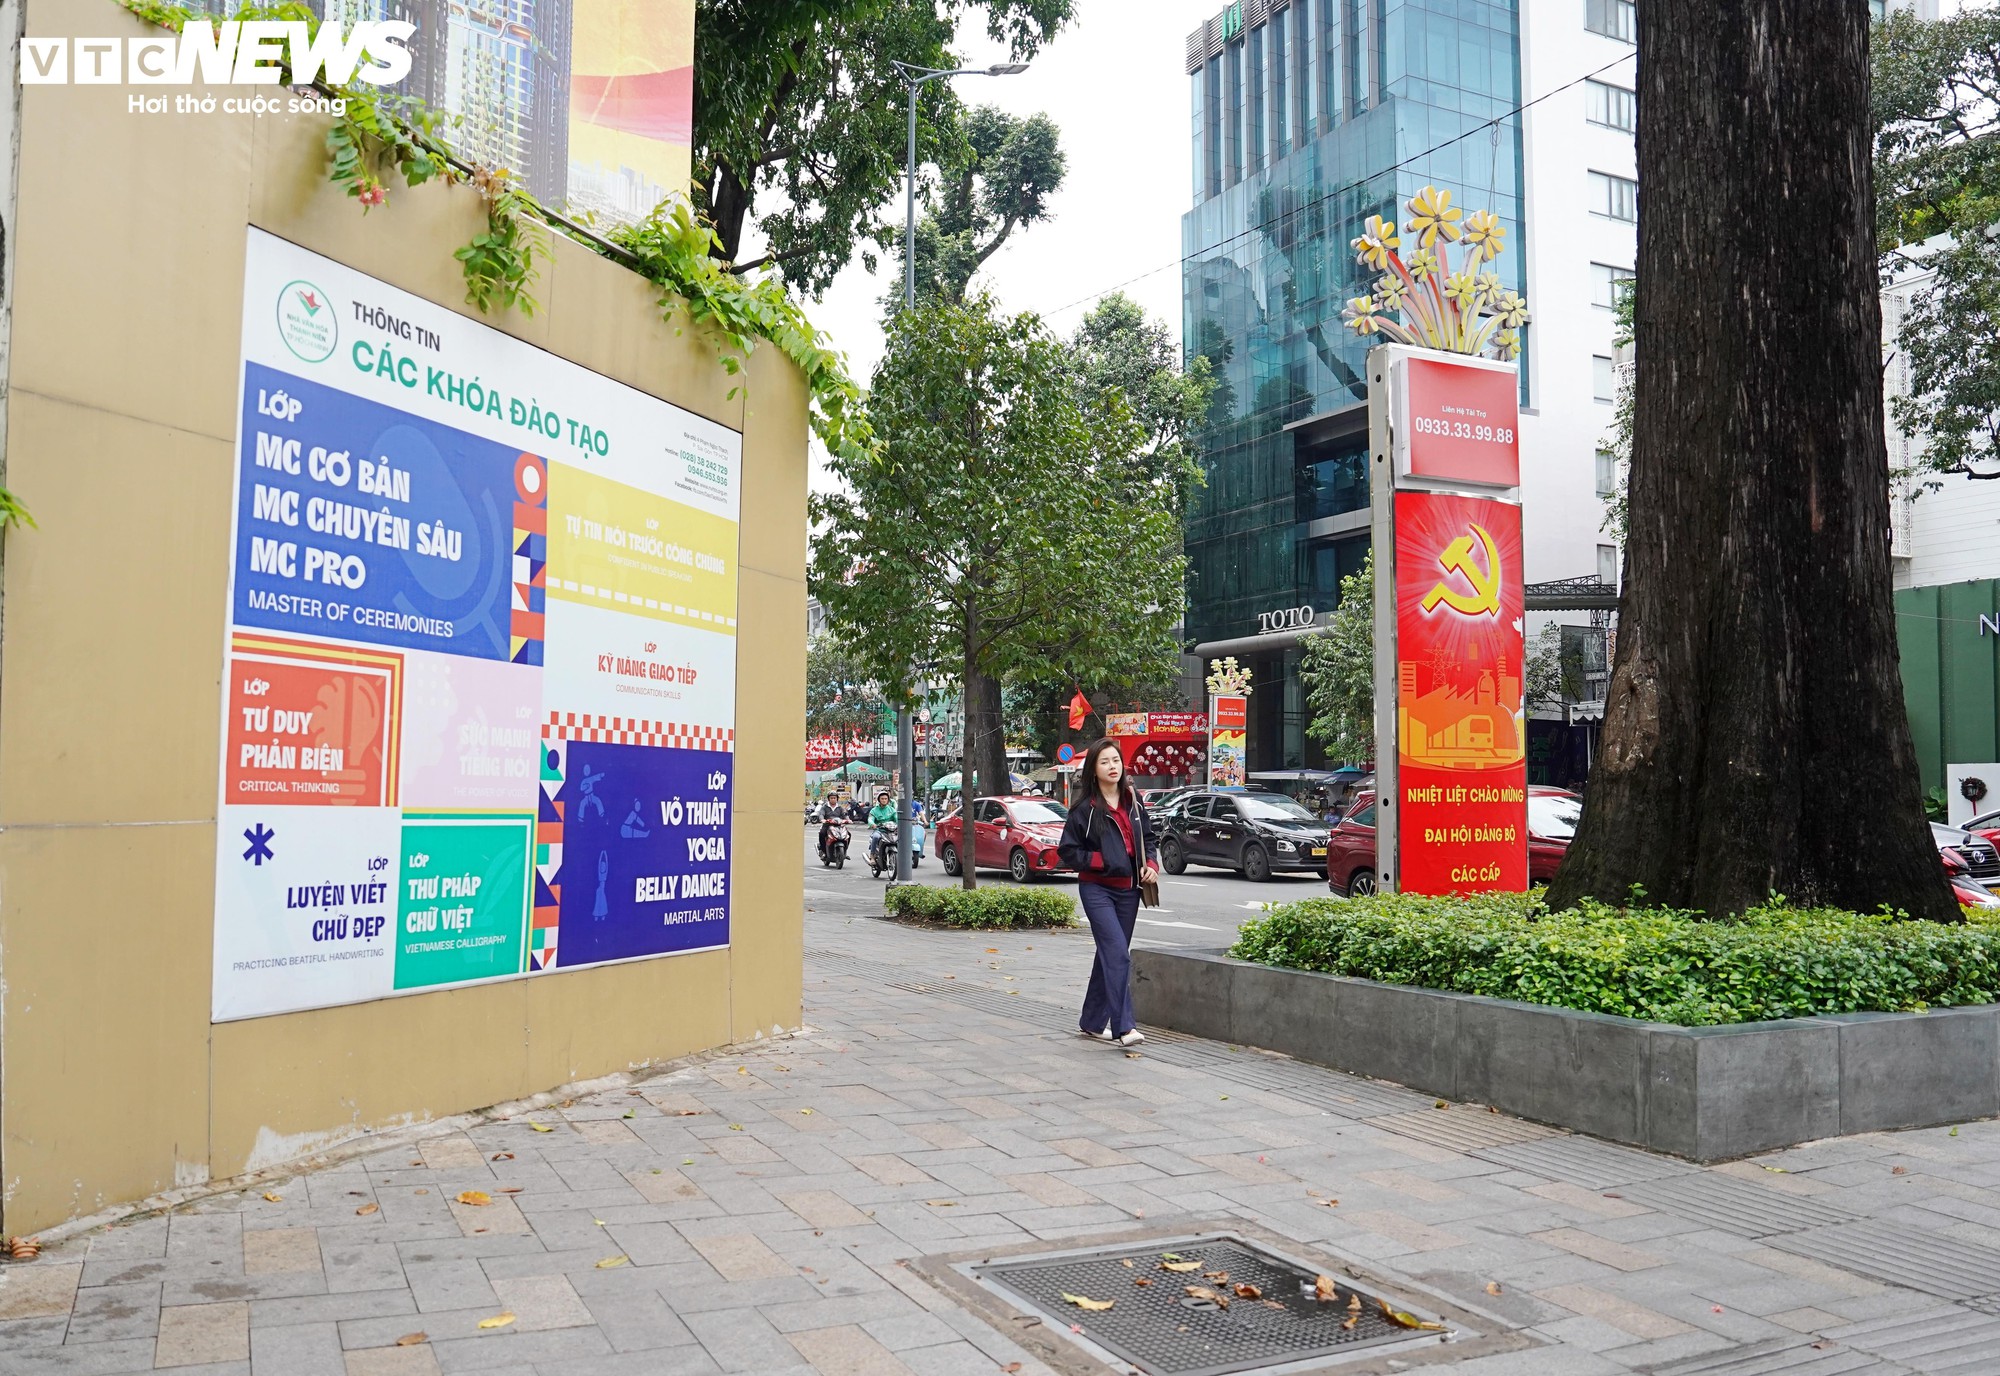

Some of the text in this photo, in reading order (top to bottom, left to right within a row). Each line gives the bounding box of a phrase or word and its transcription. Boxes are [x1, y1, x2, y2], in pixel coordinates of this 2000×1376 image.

[352, 301, 440, 352] THÔNG TIN
[257, 388, 302, 422] LỚP
[352, 340, 609, 459] CÁC KHÓA ĐÀO TẠO
[1415, 416, 1514, 444] 0933.33.99.88
[255, 431, 410, 503] MC CƠ BẢN
[680, 450, 697, 464] (028)
[697, 456, 705, 466] 38
[705, 460, 717, 472] 242
[717, 464, 728, 475] 729
[253, 483, 462, 561] MC CHUYÊN SÂU
[646, 518, 659, 531] LỚP
[565, 514, 725, 575] TỰ TIN NÓI TRƯỚC CÔNG CHÚNG
[250, 536, 366, 590] MC PRO
[249, 589, 454, 638] MASTER OF CEREMONIES
[1258, 605, 1314, 631] TOTO
[644, 641, 657, 653] LỚP
[598, 652, 697, 685] KỸ NĂNG GIAO TIẾP
[244, 677, 270, 696] LỚP
[616, 684, 681, 700] COMMUNICATION SKILLS
[242, 705, 313, 735] TƯ DUY
[491, 727, 531, 752] MẠNH
[240, 738, 344, 776] PHẢN BIỆN
[504, 755, 530, 777] NÓI
[239, 780, 340, 793] CRITICAL THINKING
[708, 770, 727, 790] LỚP
[1407, 784, 1524, 807] NHIỆT LIỆT CHÀO MỪNG
[660, 796, 727, 831] VÕ THUẬT
[1425, 823, 1516, 847] ĐẠI HỘI ĐẢNG BỘ
[409, 852, 430, 868] LỚP
[687, 837, 726, 862] YOGA
[368, 856, 389, 871] LỚP
[1451, 861, 1501, 882] CÁC CẤP
[287, 874, 387, 912] LUYỆN VIẾT
[408, 872, 482, 900] THƯ PHÁP
[635, 872, 725, 902] BELLY DANCE
[312, 913, 386, 942] CHỮ ĐẸP
[406, 904, 474, 934] CHỮ VIỆT
[664, 907, 725, 926] MARTIAL ARTS
[405, 935, 507, 954] VIETNAMESE CALLIGRAPHY
[233, 948, 385, 971] PRACTICING BEATIFUL HANDWRITING
